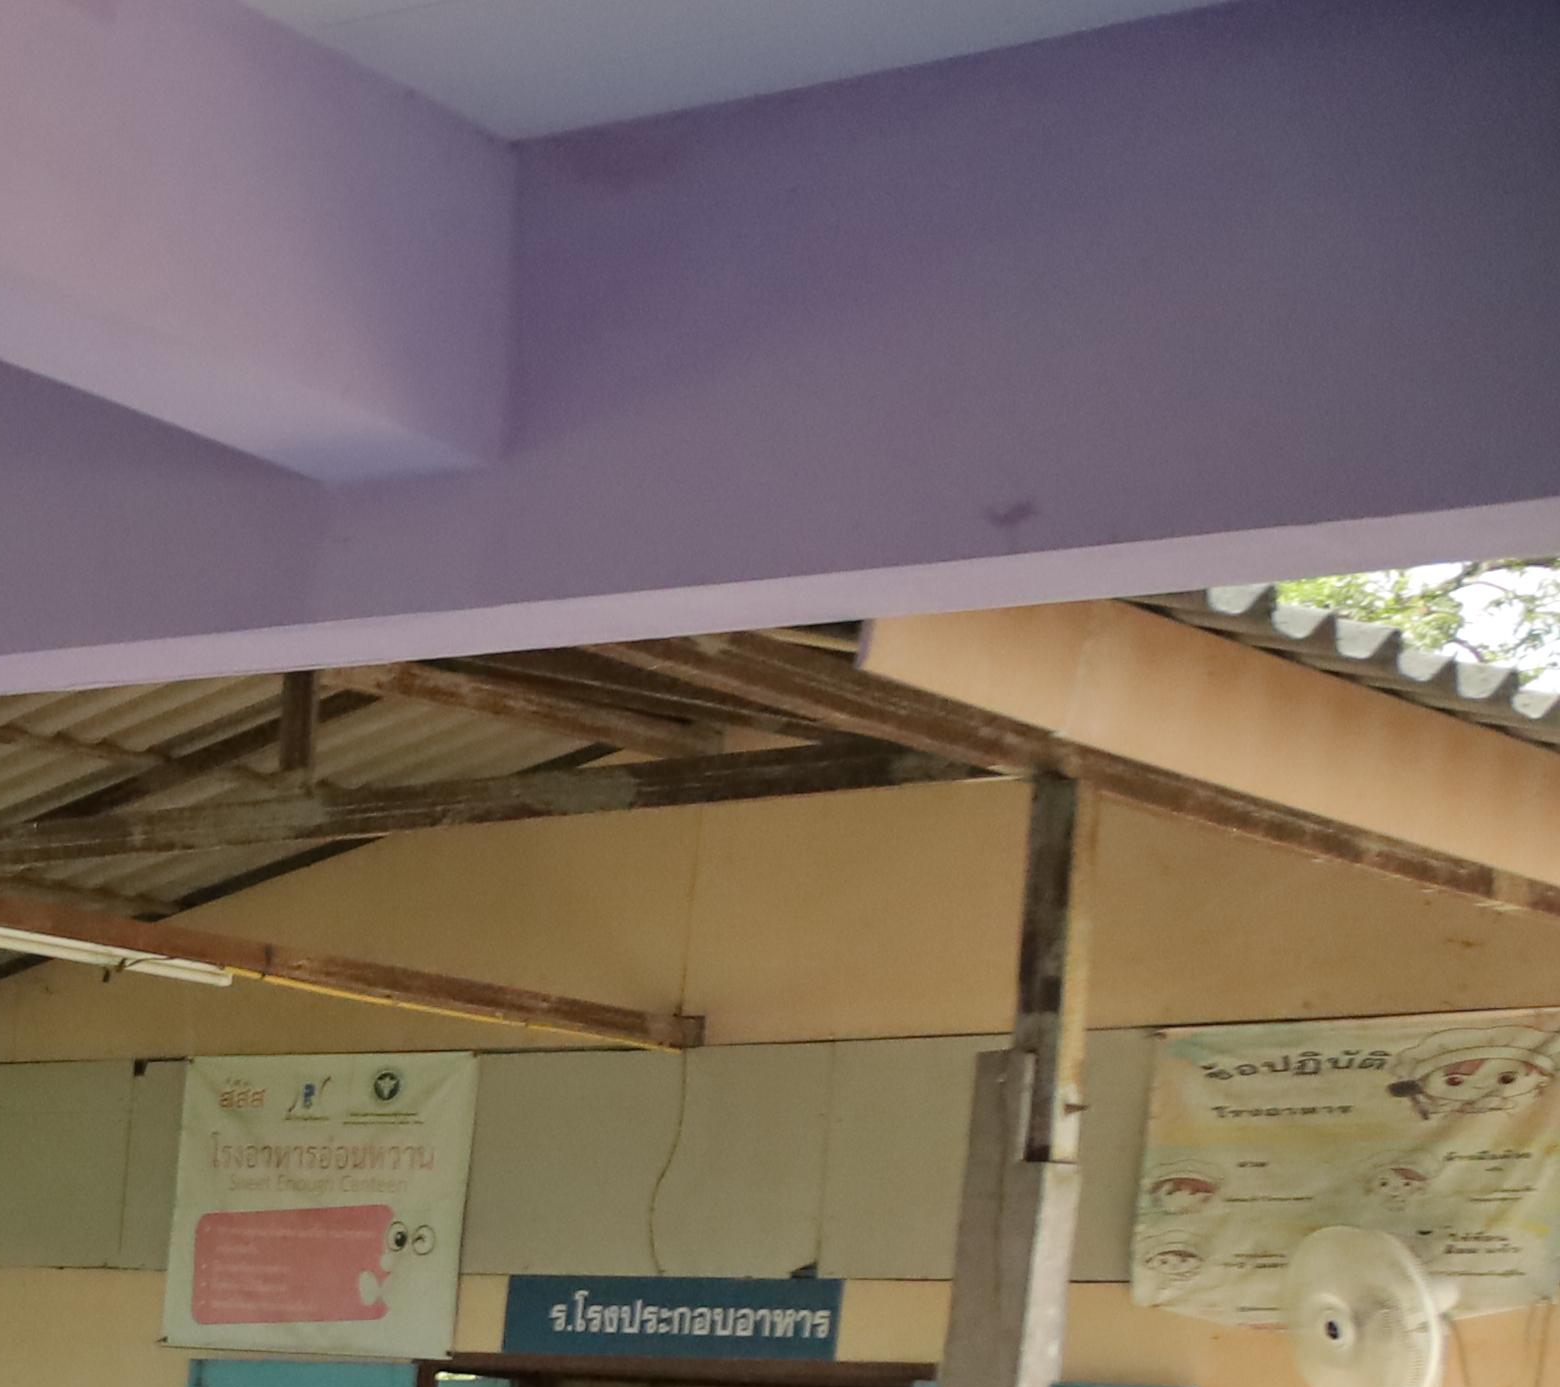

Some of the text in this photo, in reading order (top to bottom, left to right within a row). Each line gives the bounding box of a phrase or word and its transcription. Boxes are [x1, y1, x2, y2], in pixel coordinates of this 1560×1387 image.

[209, 1131, 435, 1171] โรงอาหารอ่อนหวาน
[341, 1175, 410, 1193] Canteen
